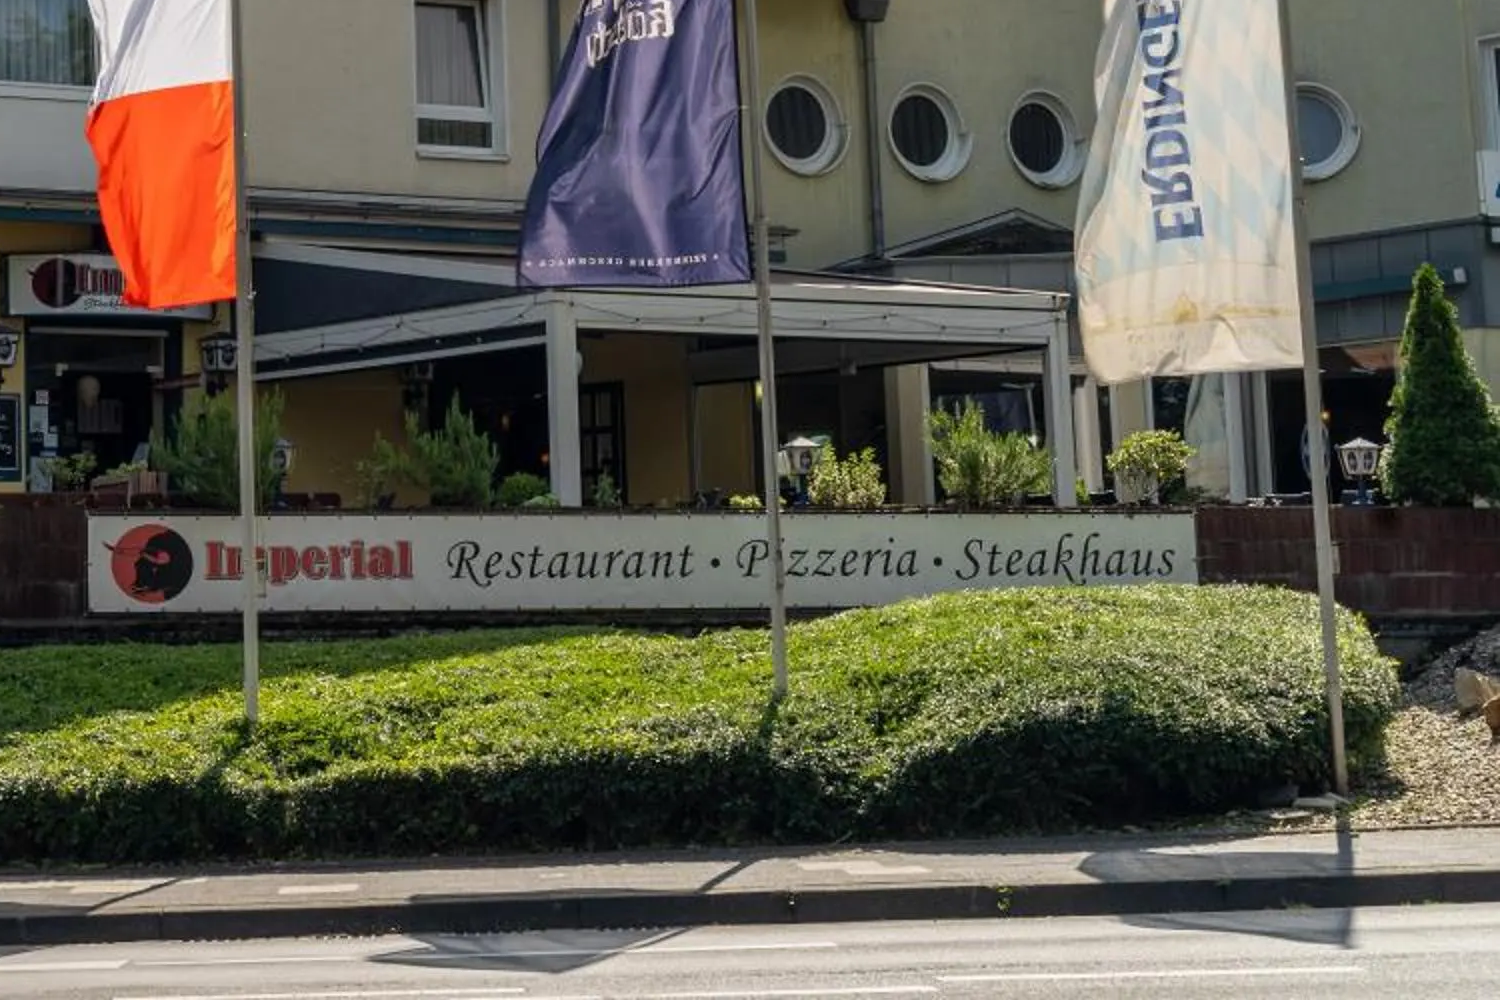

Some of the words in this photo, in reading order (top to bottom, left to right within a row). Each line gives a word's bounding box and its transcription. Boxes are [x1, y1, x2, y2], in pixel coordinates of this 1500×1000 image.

[446, 540, 695, 588] Restaurant
[736, 537, 917, 578] Pzzeria
[955, 532, 1176, 586] Steakhaus
